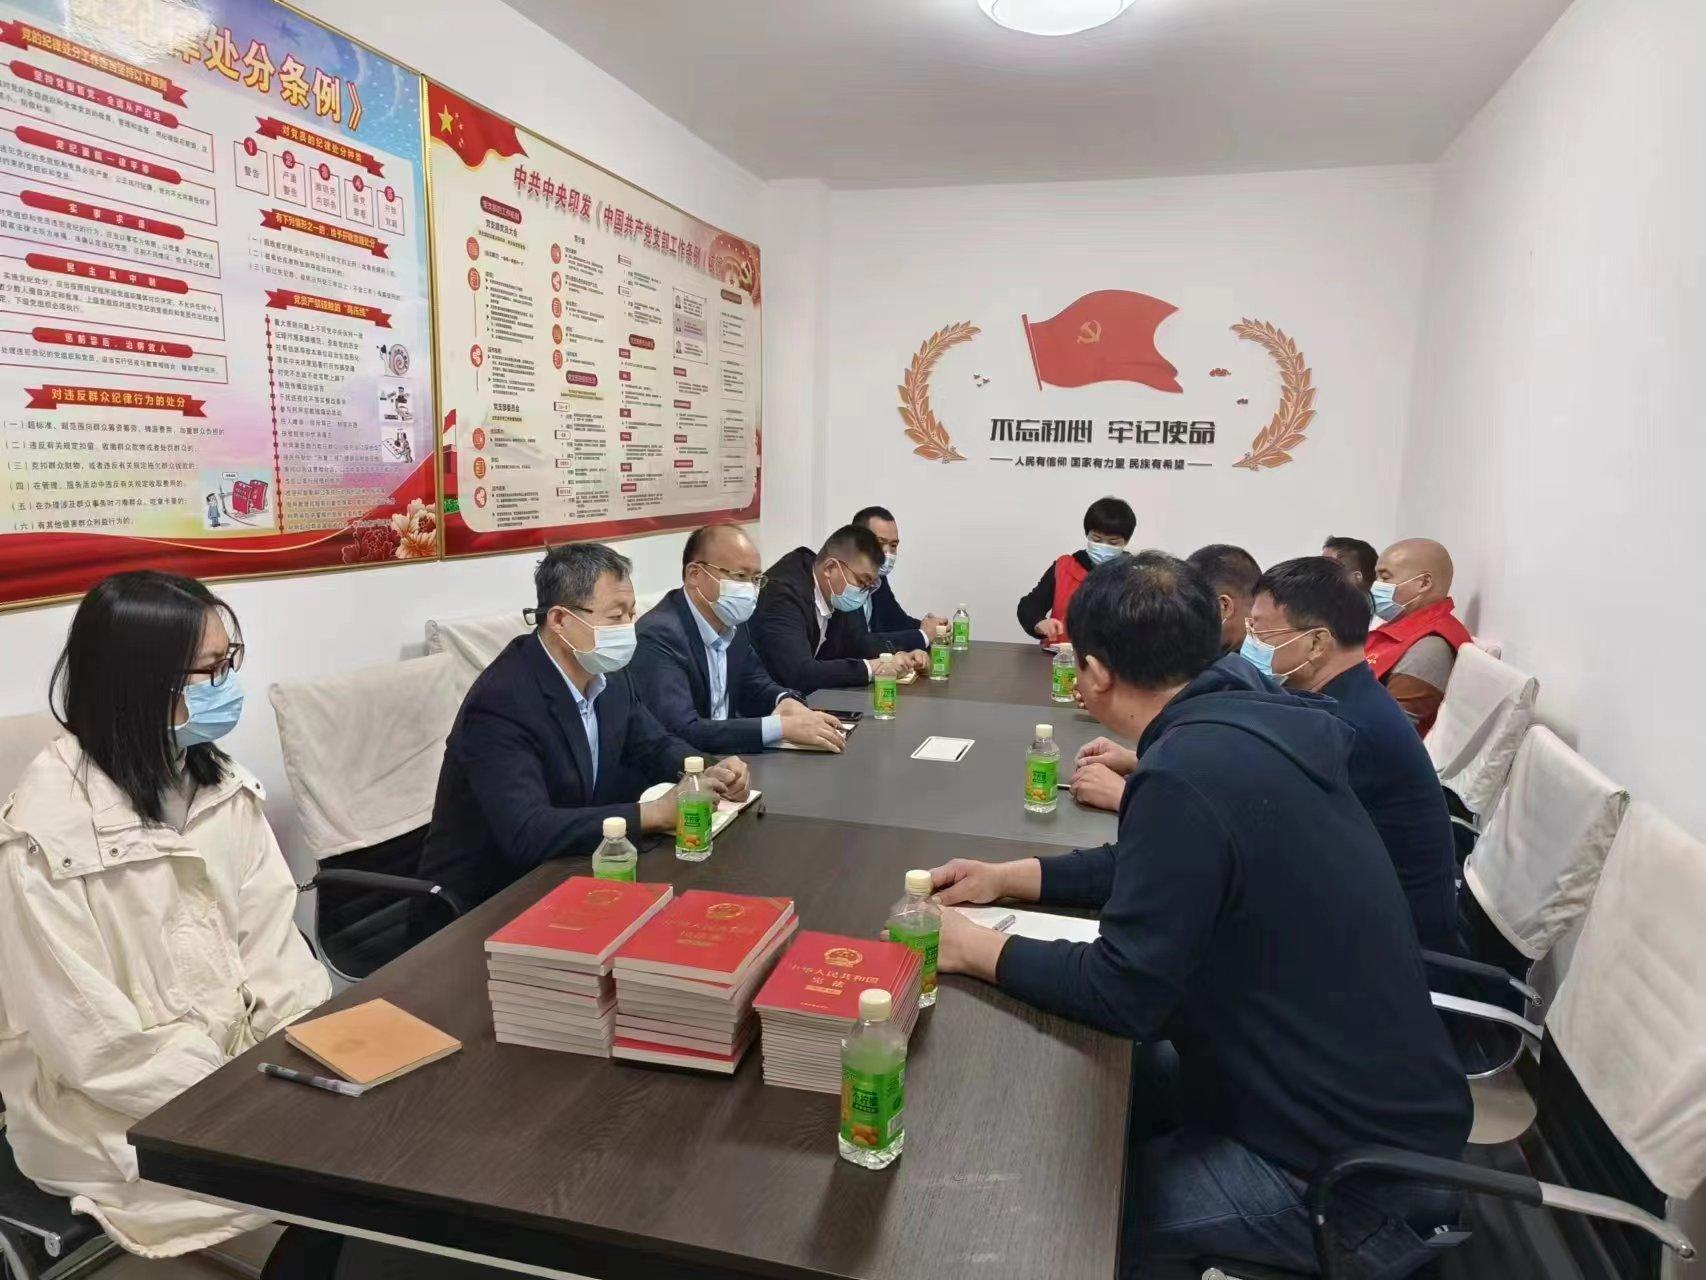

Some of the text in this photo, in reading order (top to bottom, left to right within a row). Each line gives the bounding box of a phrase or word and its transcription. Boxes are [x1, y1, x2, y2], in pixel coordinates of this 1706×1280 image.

[51, 388, 186, 408] 对违反群众纪律行为的处分
[989, 417, 1216, 444] 不忘初心 牢记使命
[1014, 455, 1186, 471] 人民有信仰 国家有力量 民族有希望
